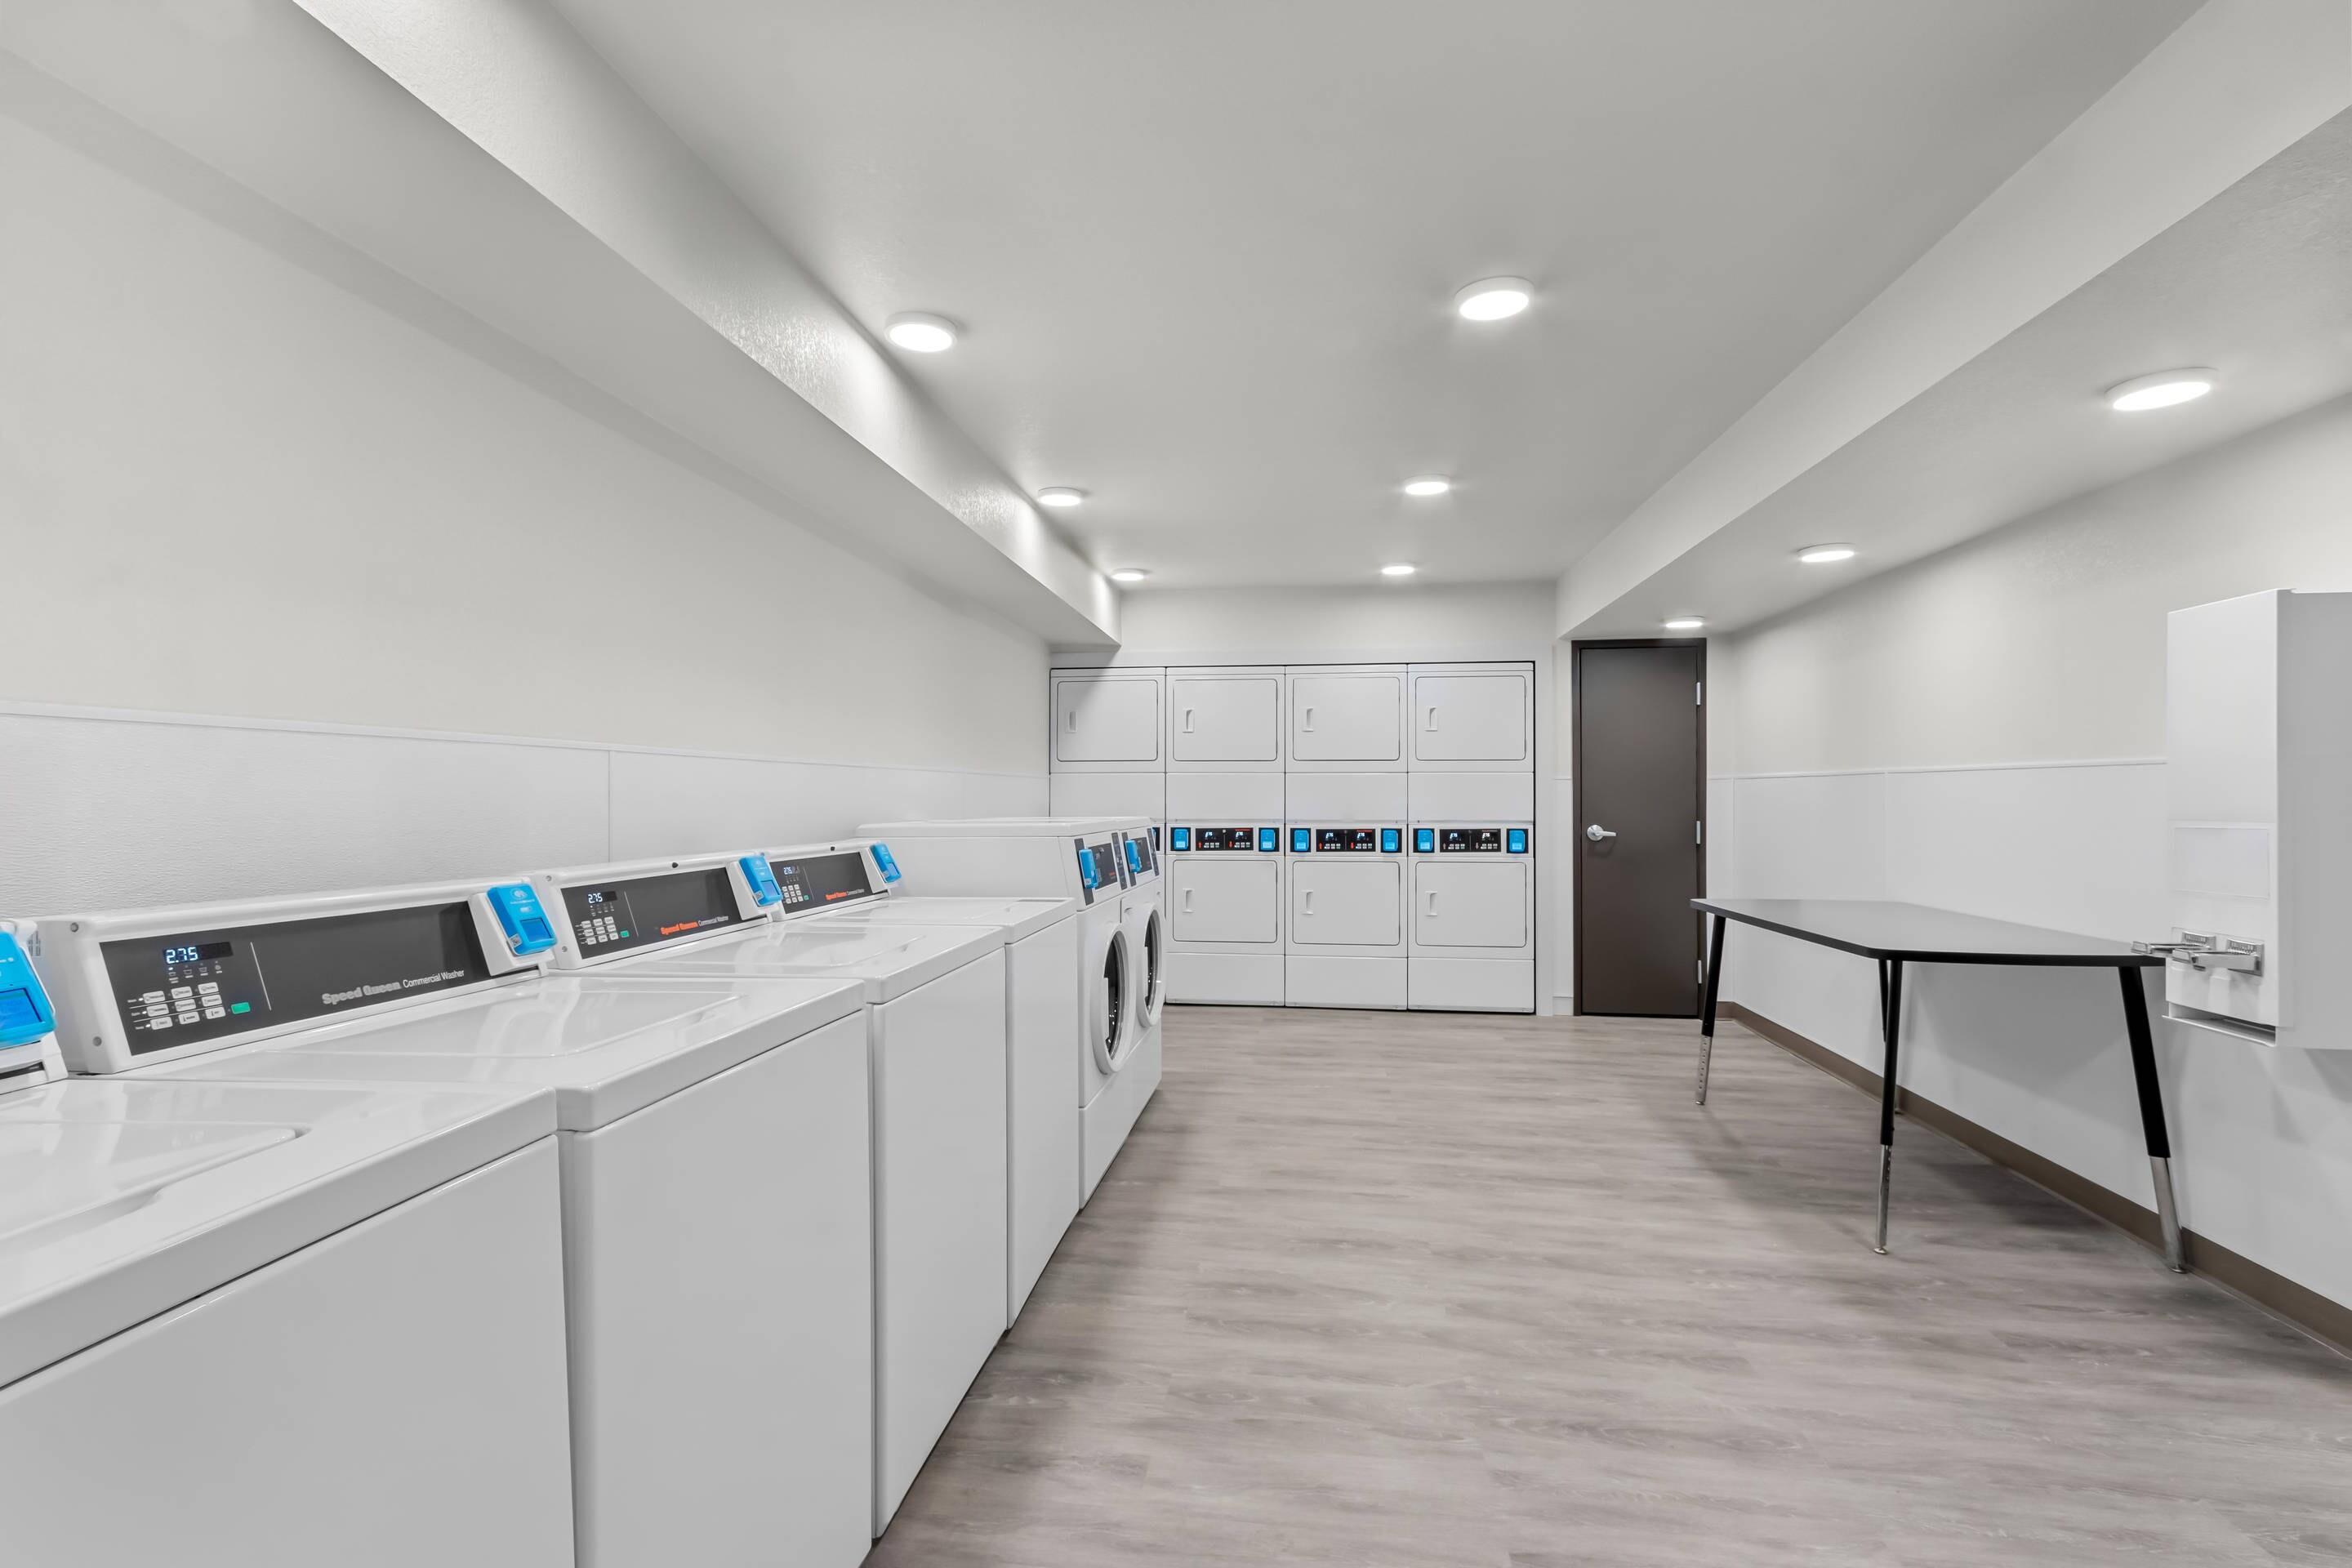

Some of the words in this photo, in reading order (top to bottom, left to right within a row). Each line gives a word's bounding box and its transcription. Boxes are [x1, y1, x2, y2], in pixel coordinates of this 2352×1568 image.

[166, 946, 198, 964] 2.75
[322, 987, 363, 1005] Speed
[363, 981, 402, 996] Queen
[403, 973, 442, 988] Commercial
[442, 969, 465, 981] Washer
